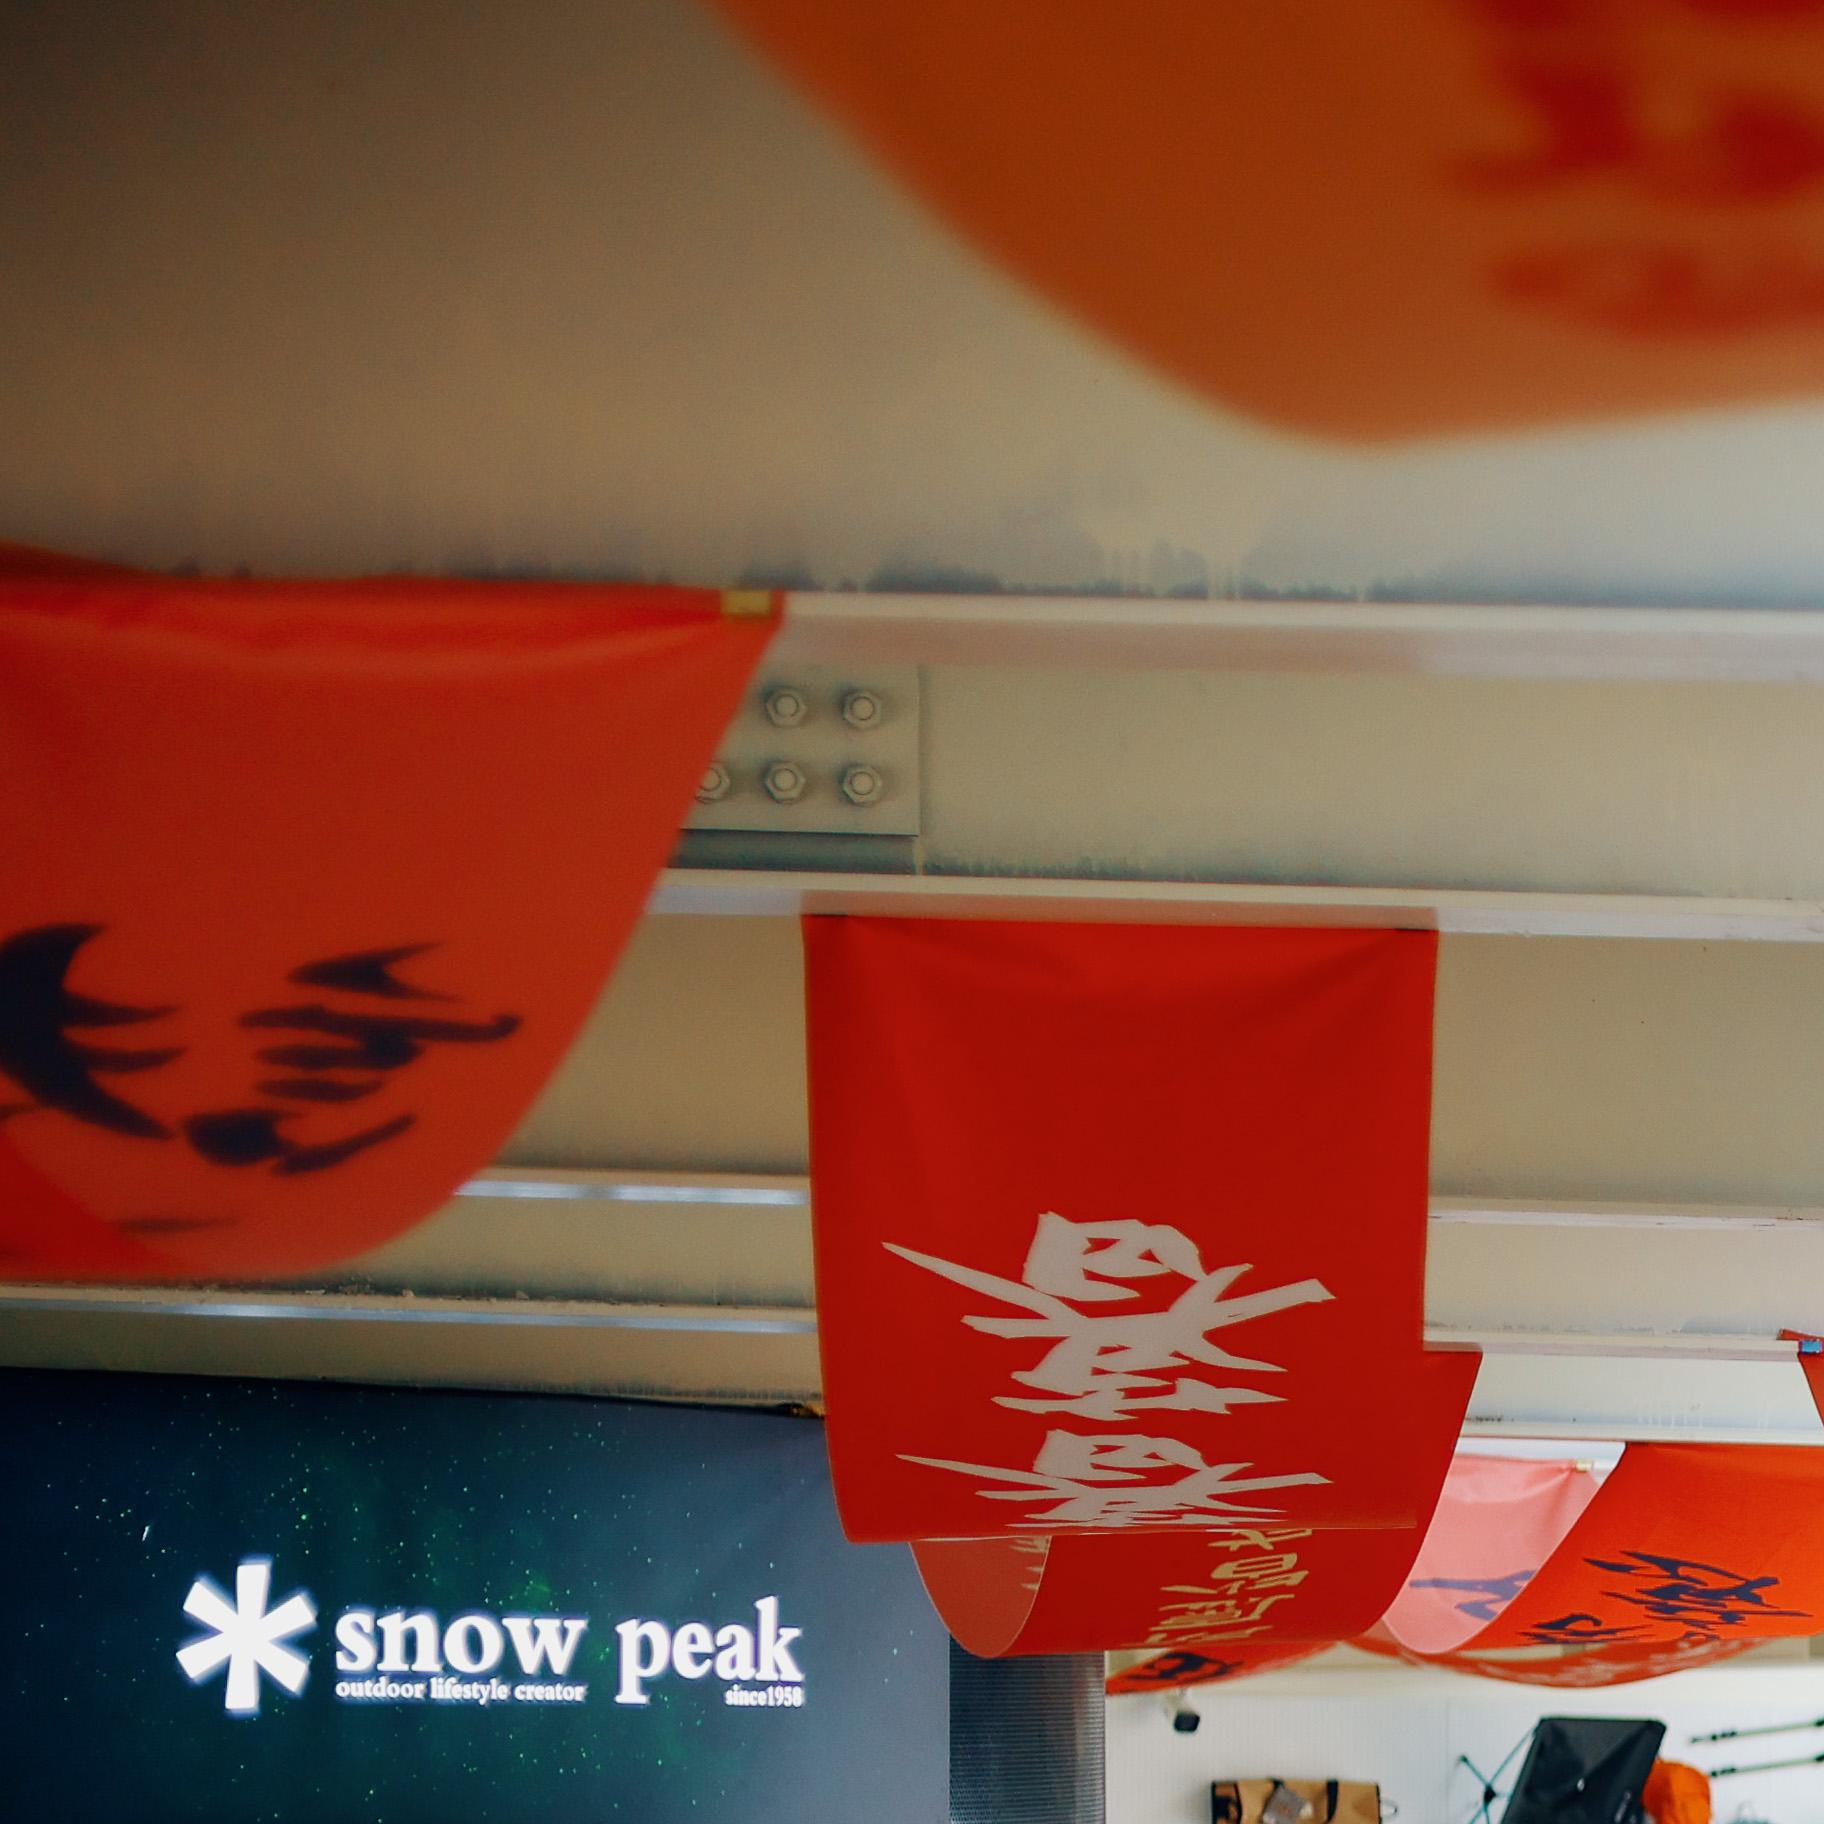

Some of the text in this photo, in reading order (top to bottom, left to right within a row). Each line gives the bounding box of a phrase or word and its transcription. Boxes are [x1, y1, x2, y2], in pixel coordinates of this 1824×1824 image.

[334, 1595, 805, 1705] snow peak
[335, 1677, 588, 1706] outdoor lifestyle creator
